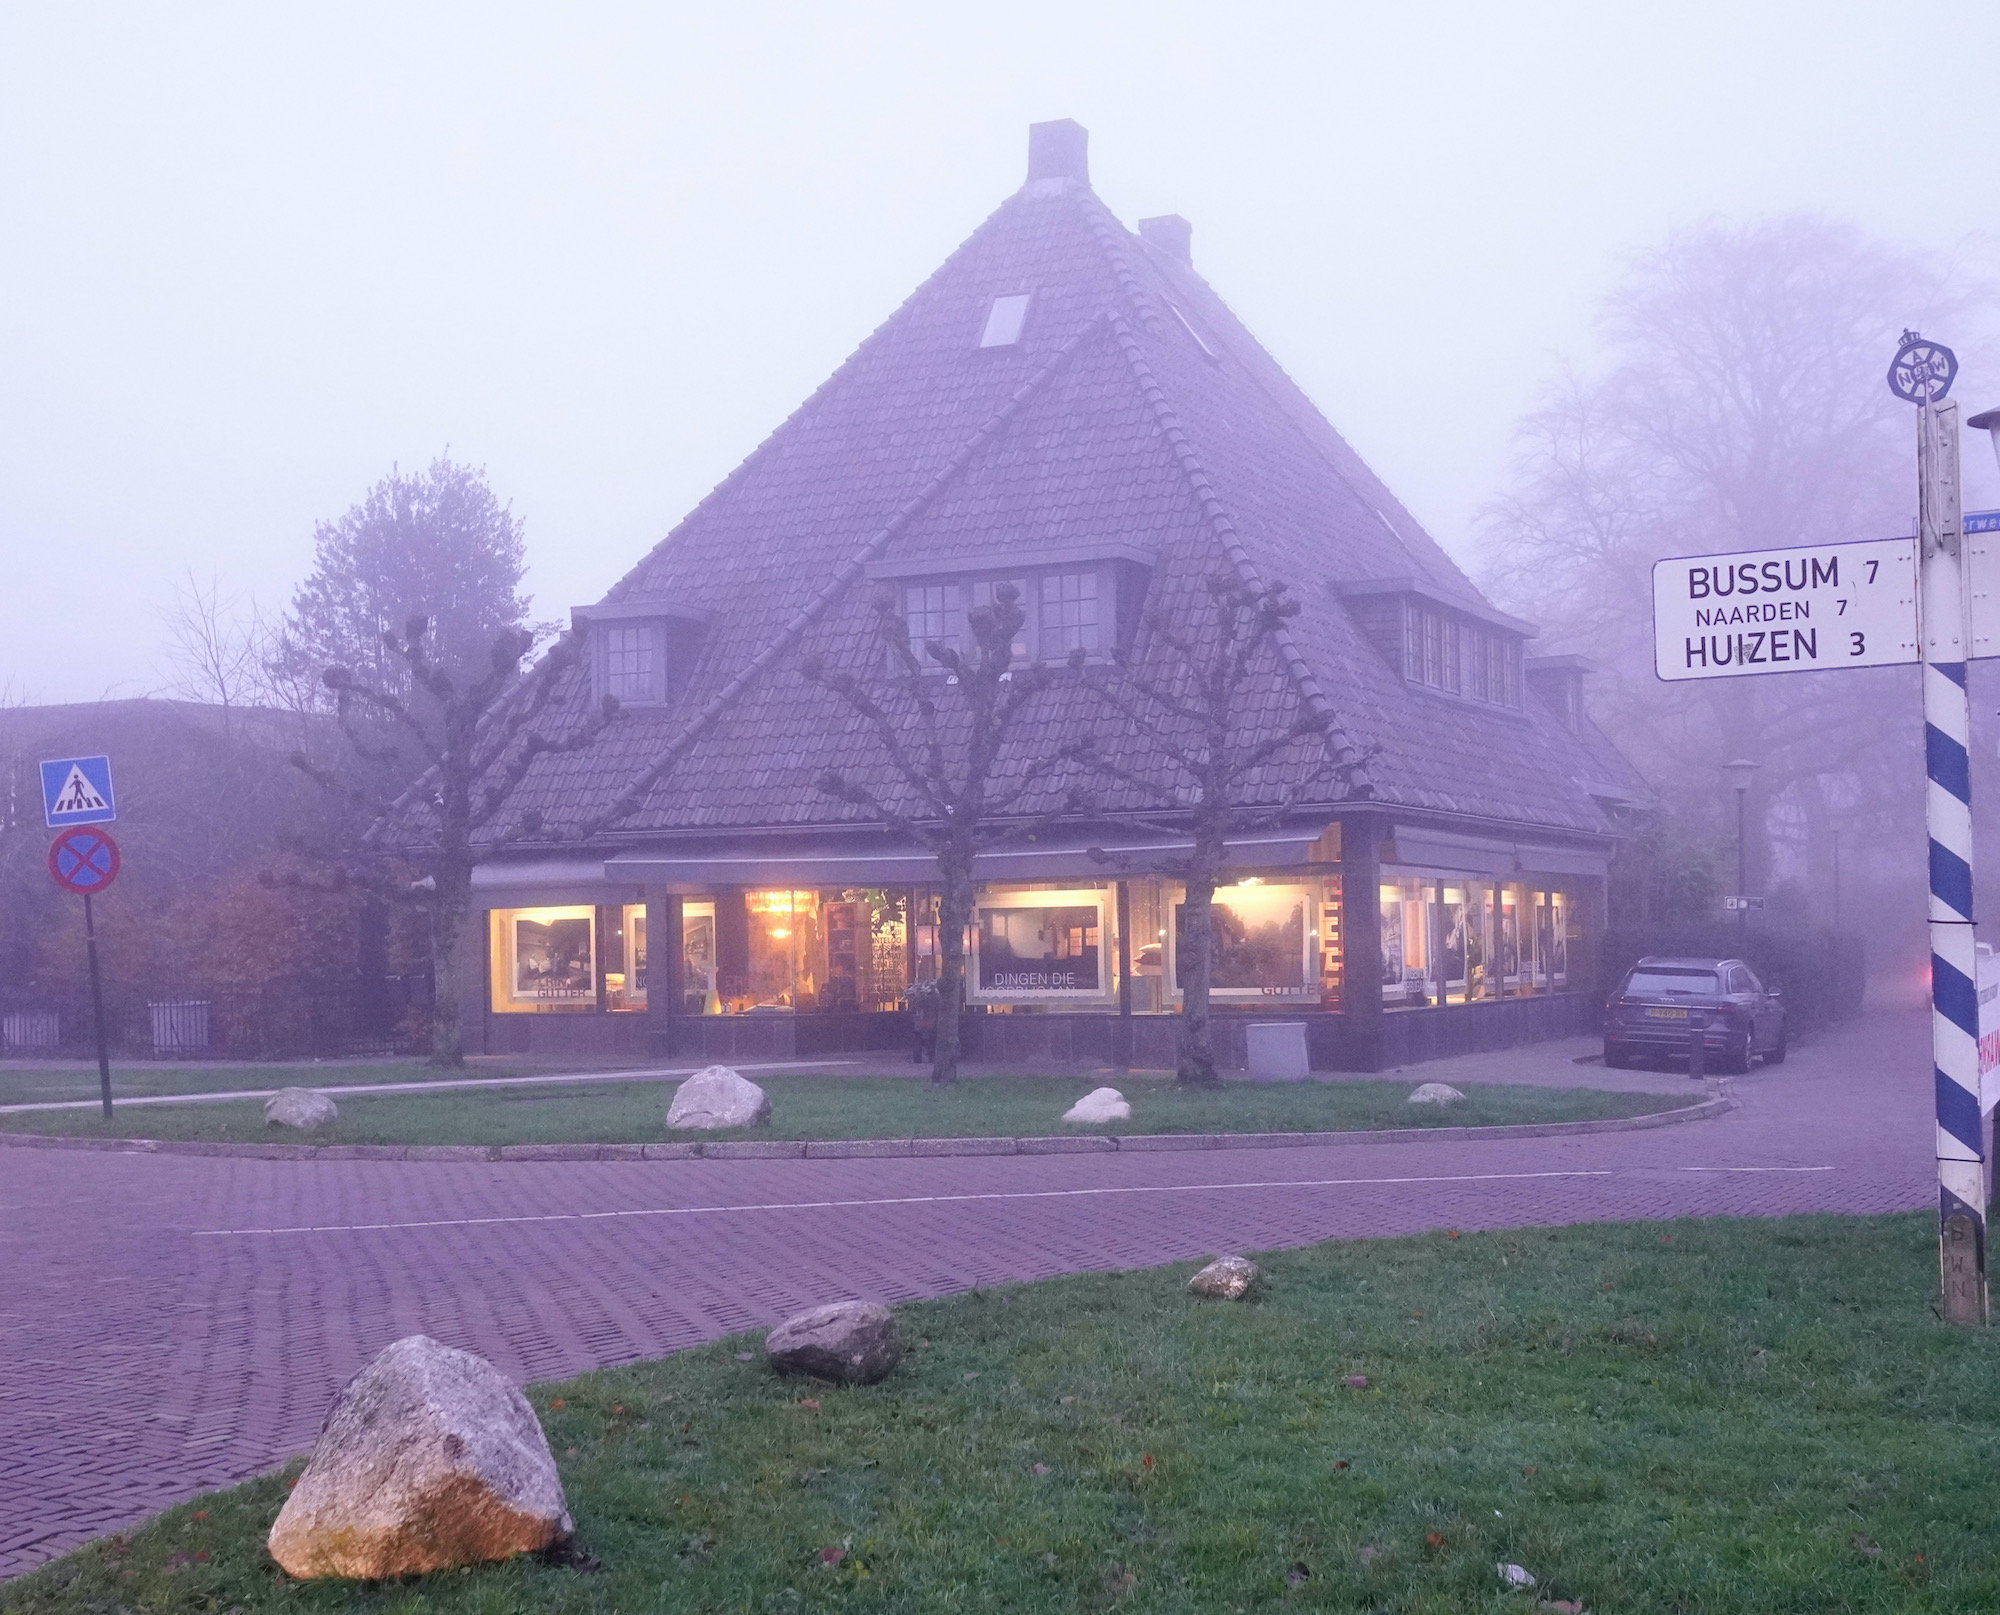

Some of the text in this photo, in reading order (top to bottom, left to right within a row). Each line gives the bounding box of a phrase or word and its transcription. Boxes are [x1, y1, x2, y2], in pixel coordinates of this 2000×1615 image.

[1964, 517, 2000, 533] rwe
[1689, 555, 1879, 599] BUSSUM 7
[1696, 599, 1848, 627] NAARDEN 7
[1685, 628, 1866, 668] HUIZEN 3
[994, 972, 1075, 985] DINGEN DIE
